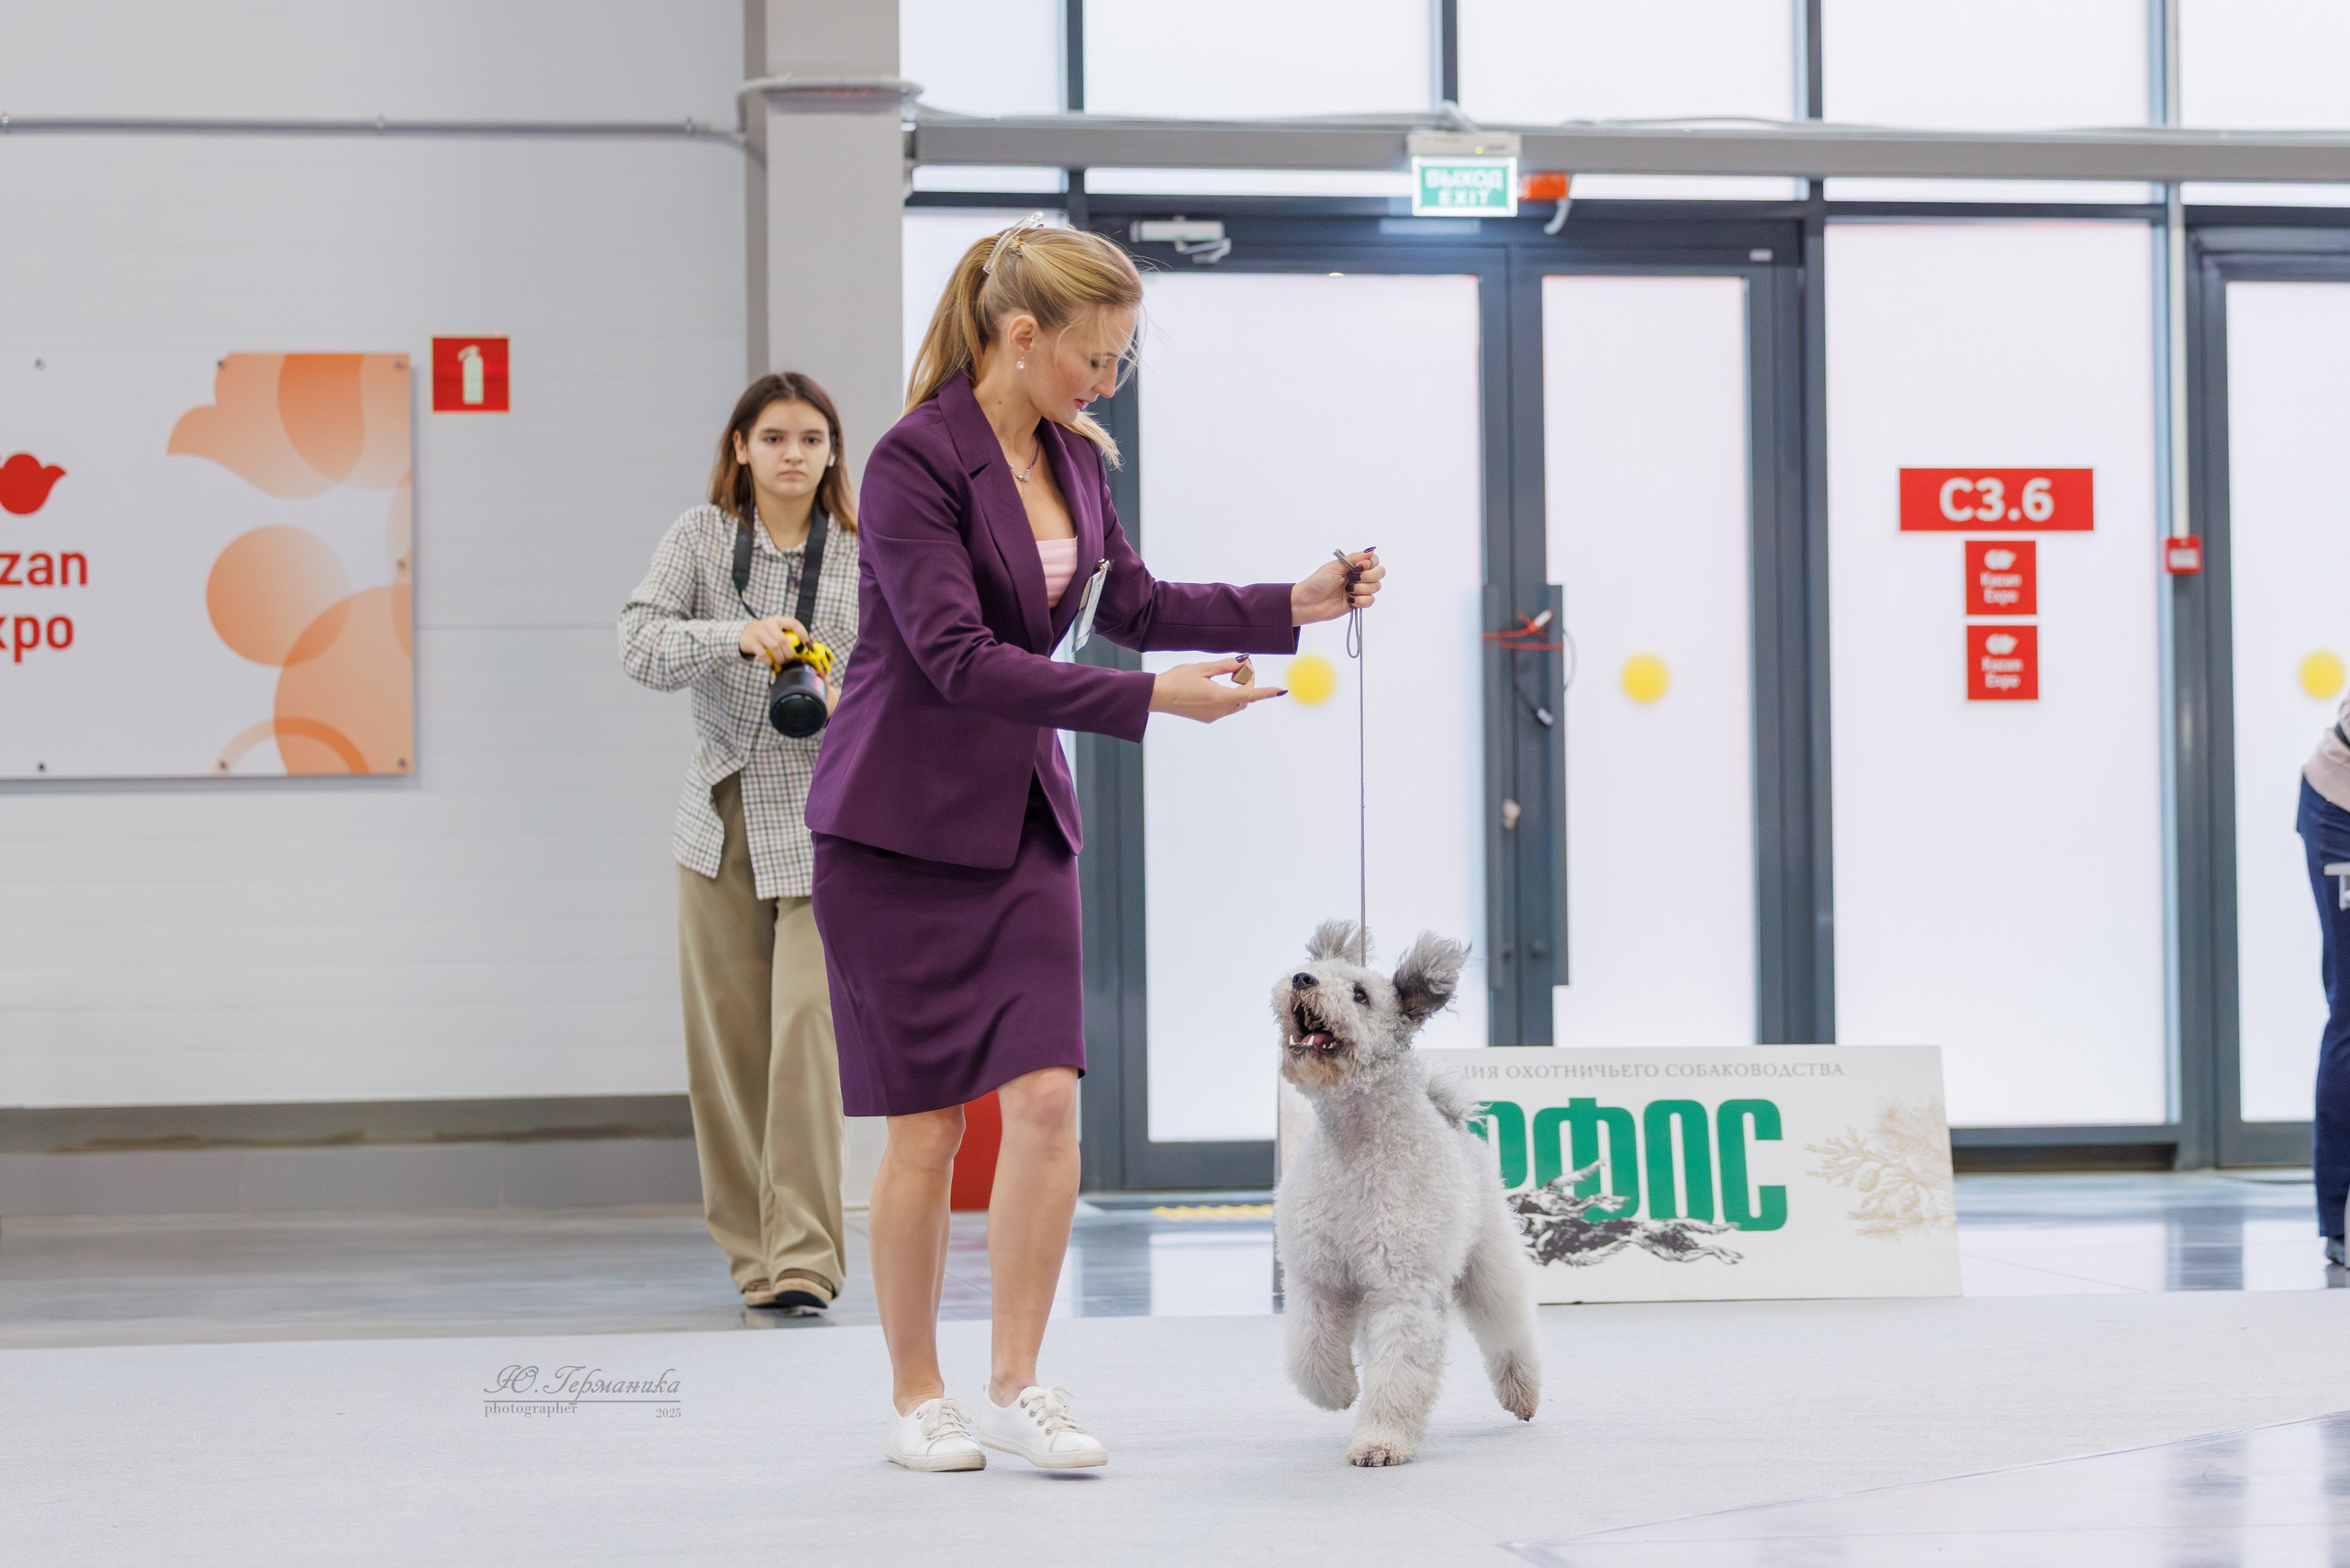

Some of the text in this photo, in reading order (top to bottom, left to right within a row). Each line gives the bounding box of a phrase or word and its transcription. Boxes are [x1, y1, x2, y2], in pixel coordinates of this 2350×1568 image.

[1438, 189, 1489, 207] EXIT
[1505, 1063, 1659, 1080] ОХОТНИЧЬЕГО
[1664, 1062, 1844, 1079] СОБАКОВОДСТВА
